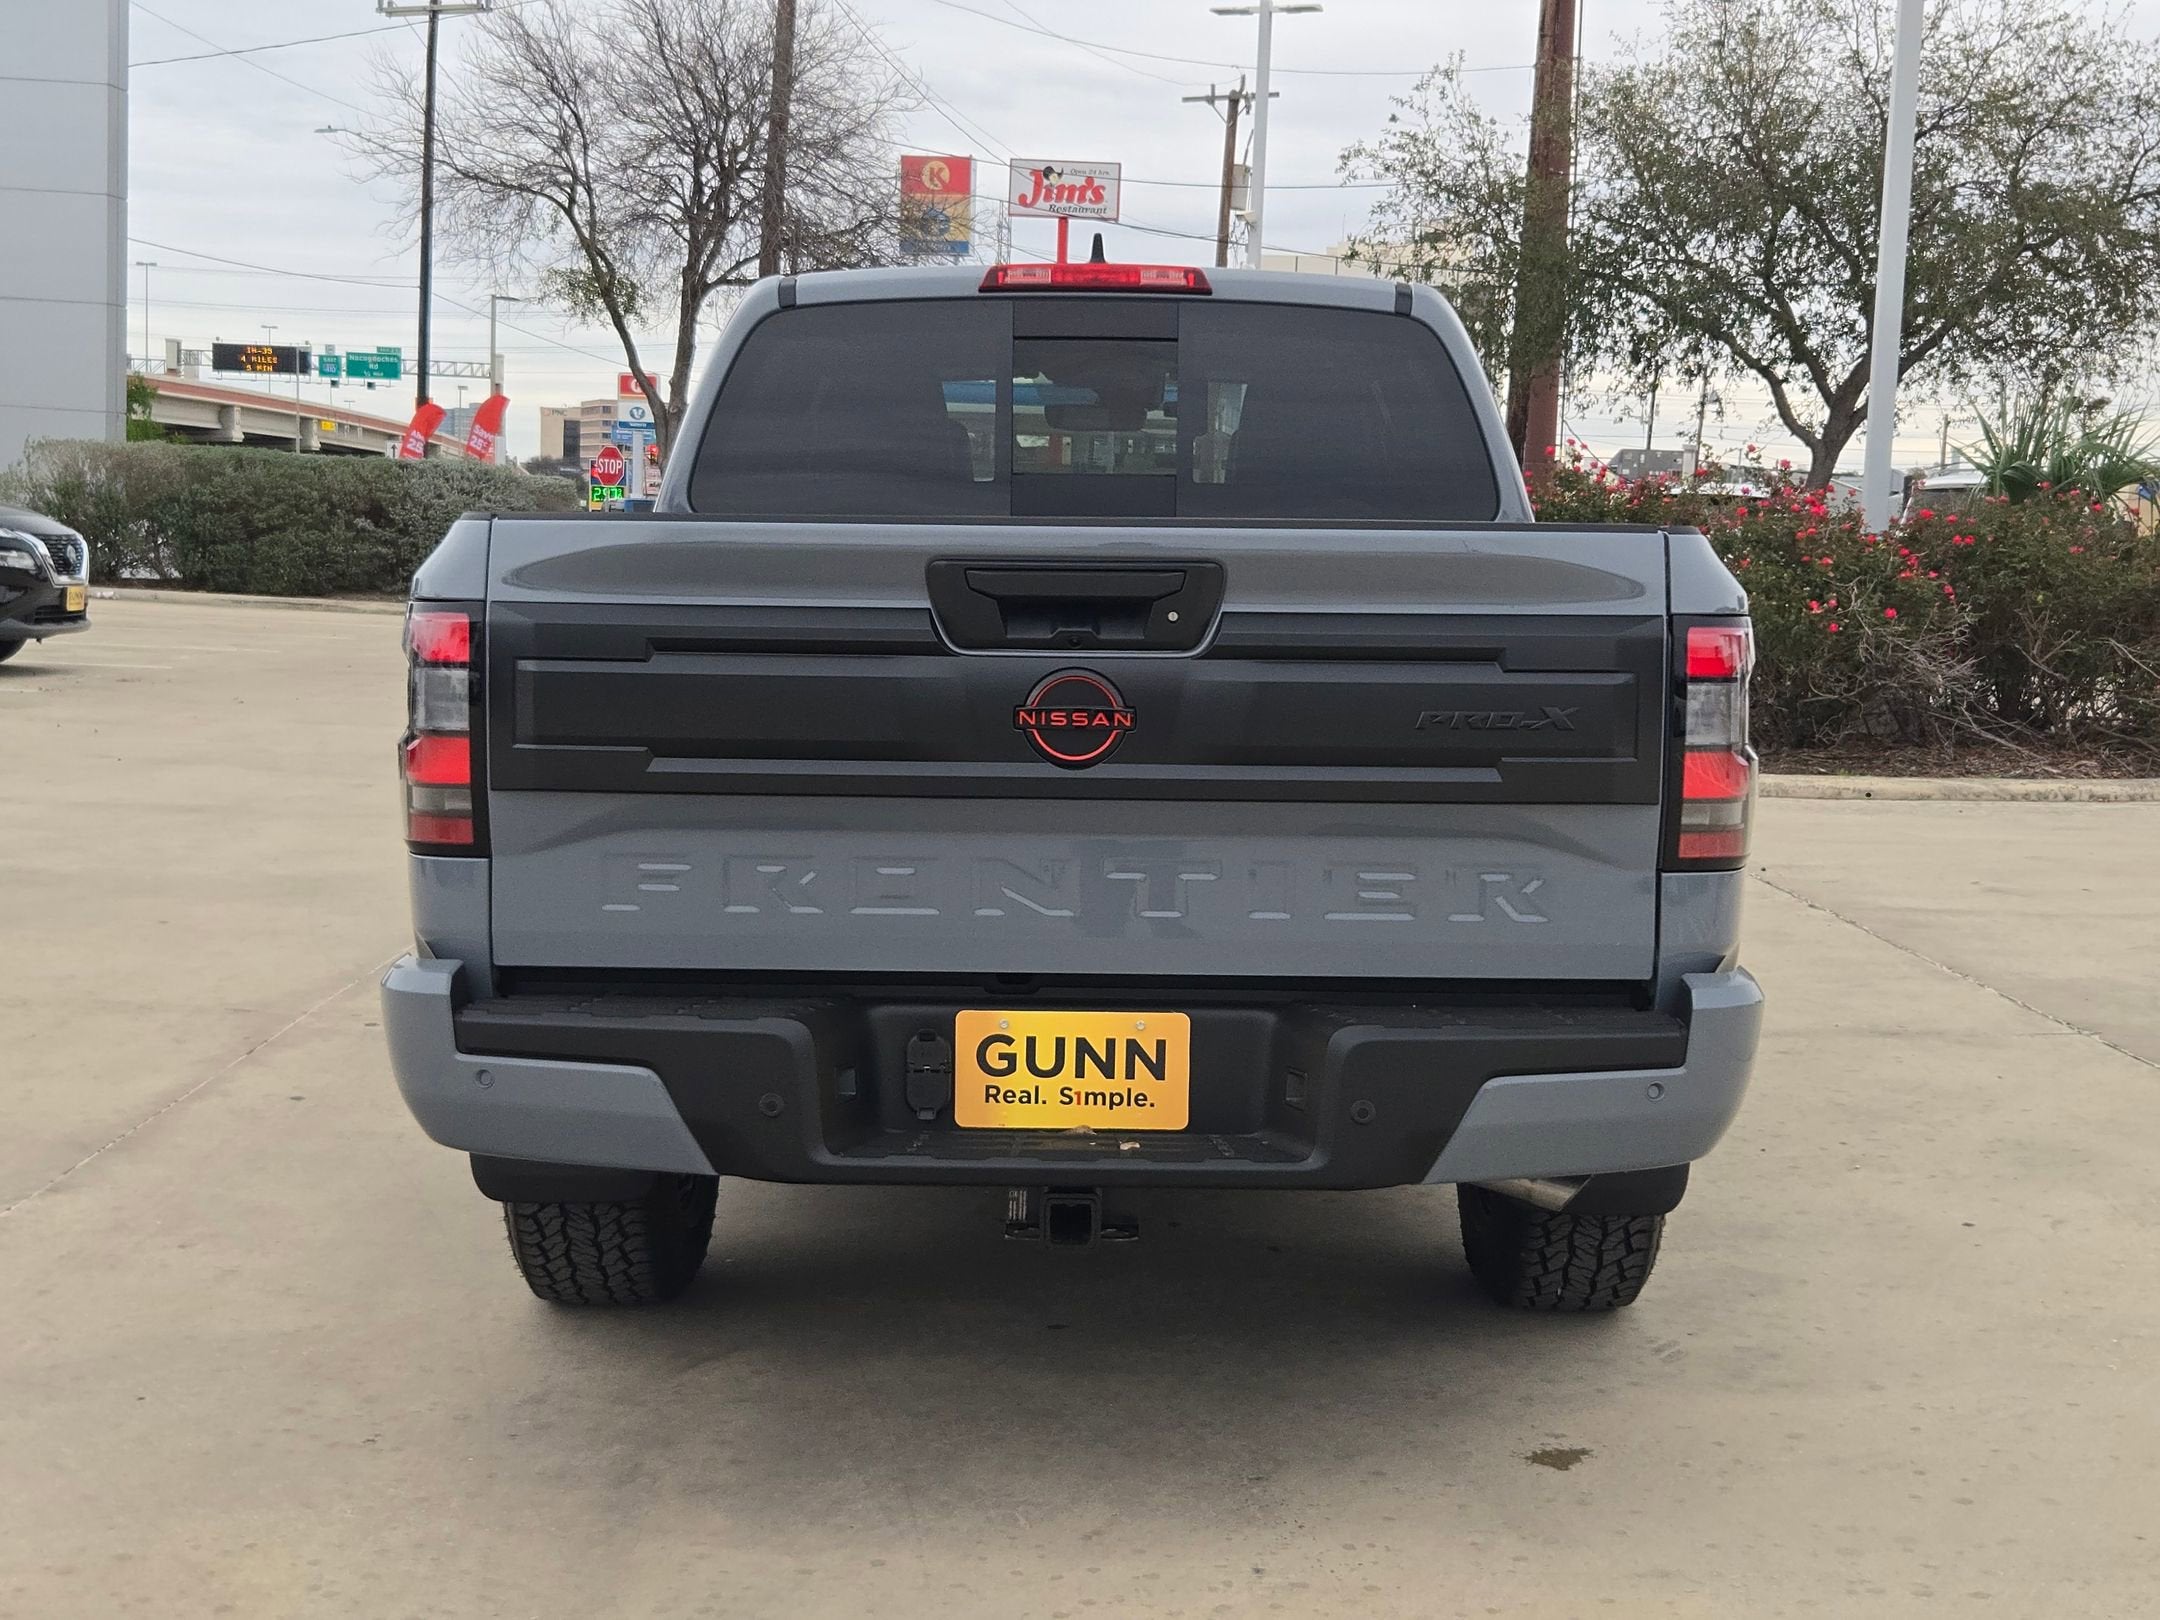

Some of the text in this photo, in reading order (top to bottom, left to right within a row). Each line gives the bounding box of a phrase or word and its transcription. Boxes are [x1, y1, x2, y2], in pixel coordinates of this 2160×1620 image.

[1018, 170, 1106, 208] Jim's
[1048, 204, 1108, 214] Restaurant
[251, 356, 278, 364] MILES
[598, 458, 622, 475] STOP
[1018, 710, 1134, 728] NISSAN
[602, 854, 1550, 923] FRONTIER
[976, 1033, 1167, 1081] GUNN
[985, 1084, 1047, 1105] Real.
